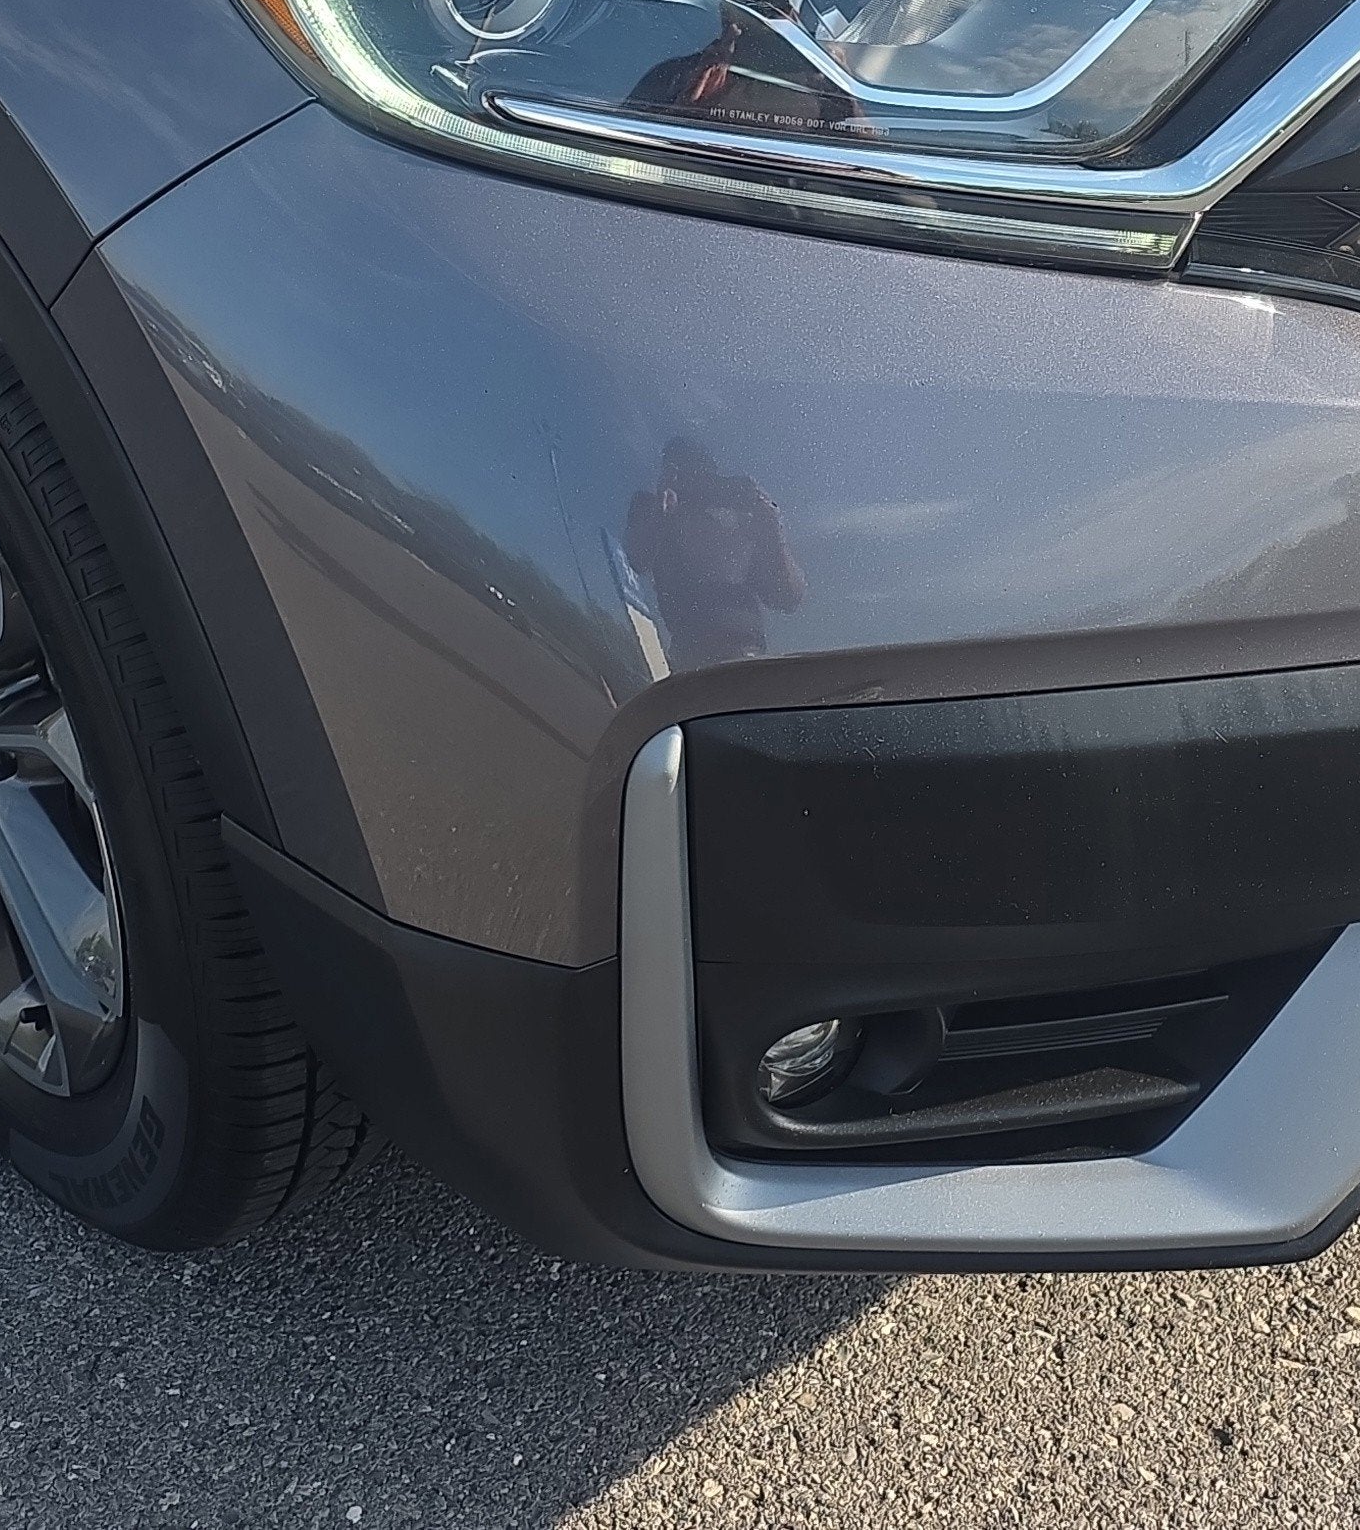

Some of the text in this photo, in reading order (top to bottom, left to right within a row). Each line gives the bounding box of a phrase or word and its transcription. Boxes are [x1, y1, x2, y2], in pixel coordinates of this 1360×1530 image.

[710, 107, 726, 117] H11
[729, 109, 770, 123] STANLEY
[806, 119, 825, 129] DOT
[829, 121, 847, 132] VOR
